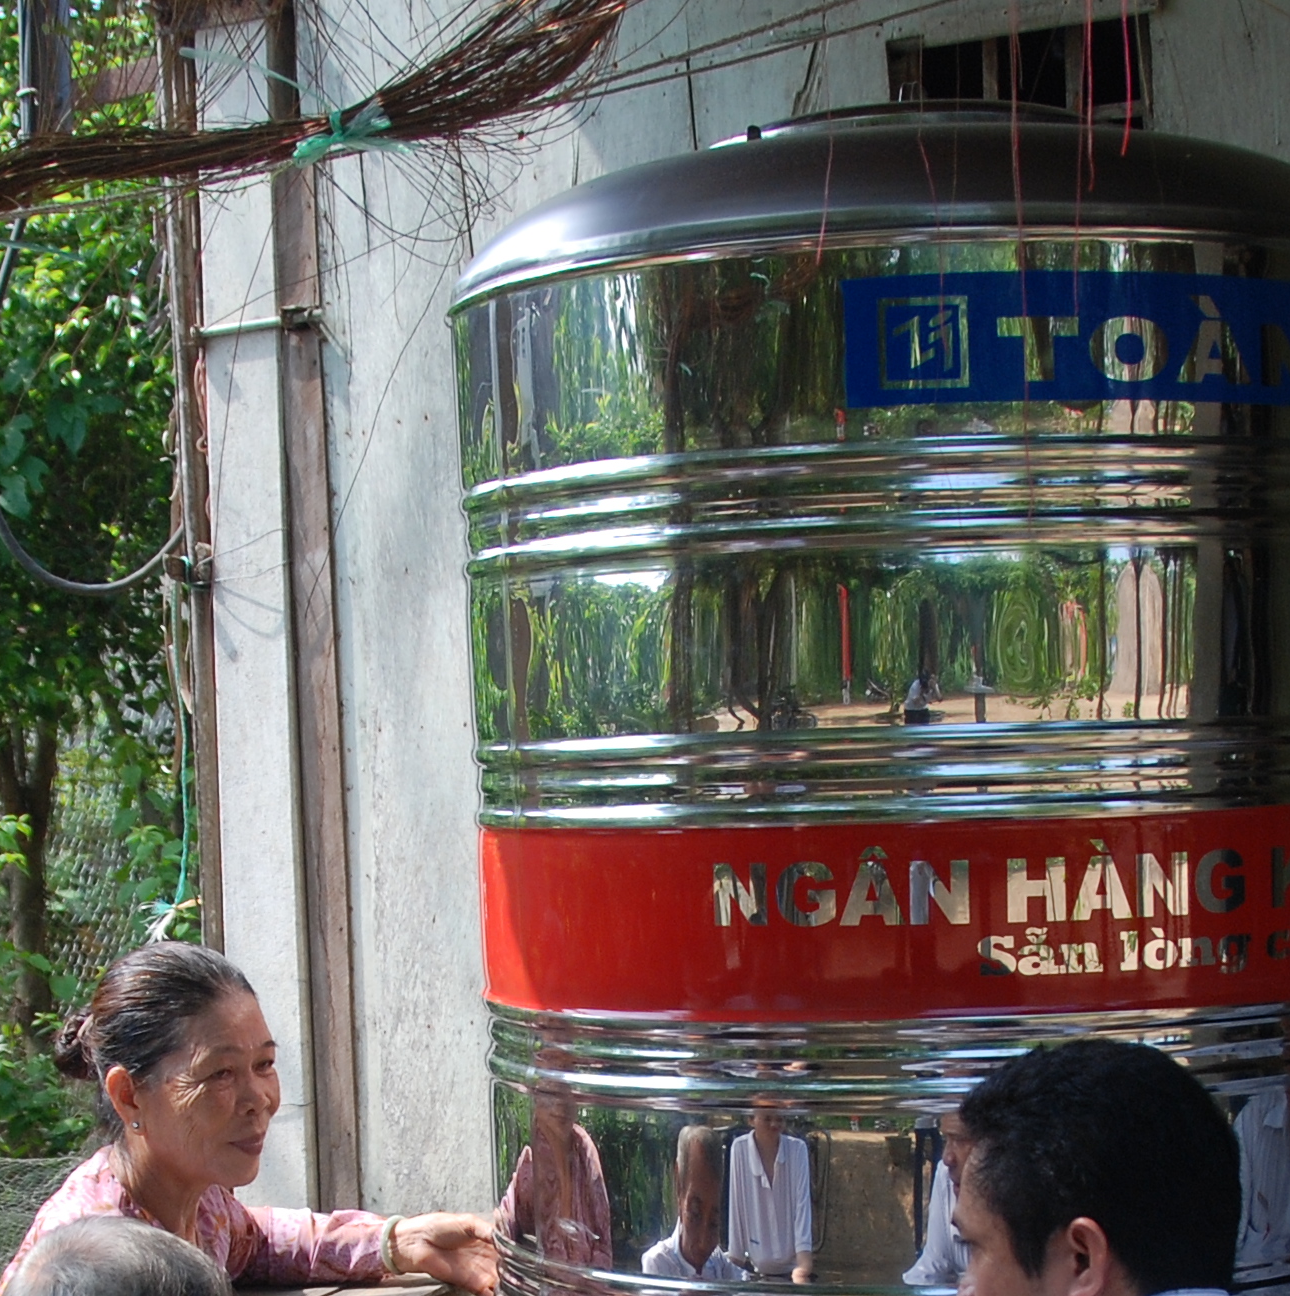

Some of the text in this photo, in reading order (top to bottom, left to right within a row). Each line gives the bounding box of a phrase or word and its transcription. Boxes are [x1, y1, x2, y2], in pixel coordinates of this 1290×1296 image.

[712, 845, 971, 927] NGÂN
[1006, 838, 1247, 923] HÀNG
[977, 926, 1104, 976] Sẵn
[1119, 926, 1251, 974] lòng
